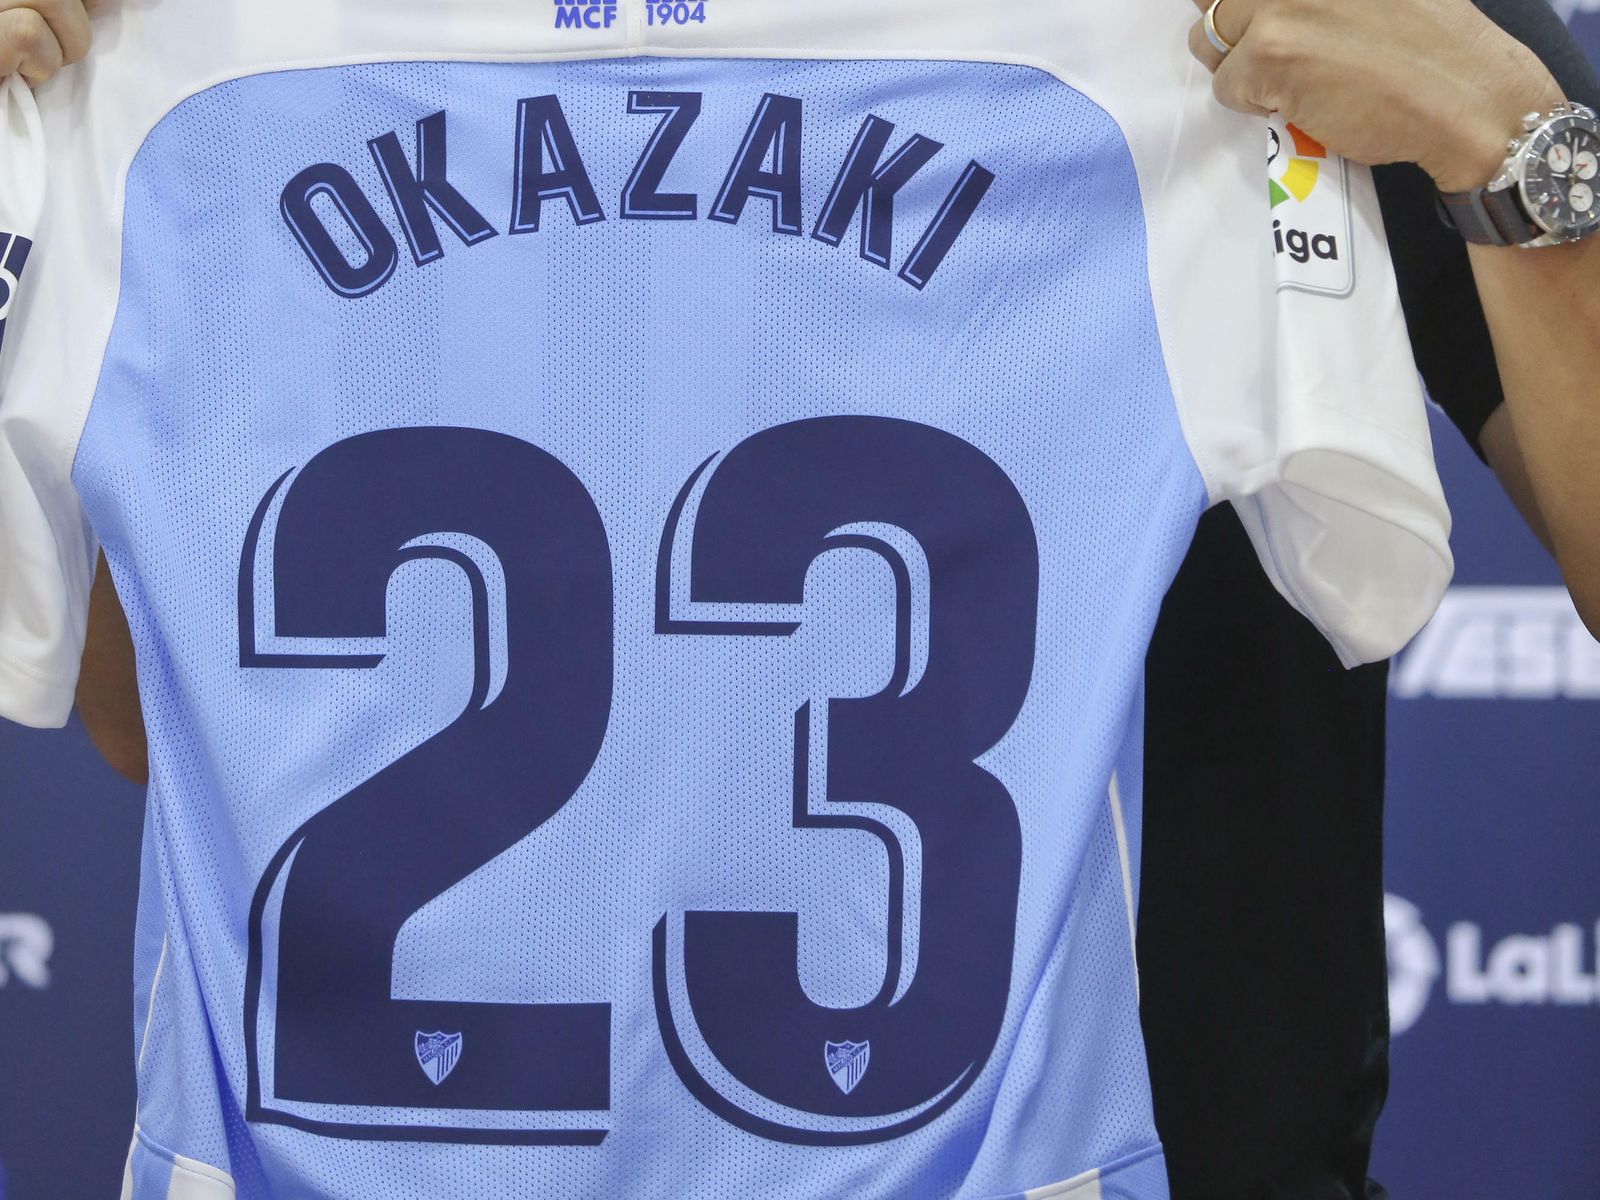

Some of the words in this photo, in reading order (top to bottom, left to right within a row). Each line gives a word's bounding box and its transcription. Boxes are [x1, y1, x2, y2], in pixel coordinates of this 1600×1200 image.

[554, 6, 617, 29] MCF
[645, 2, 706, 26] 1904
[279, 90, 997, 300] OKAZAKI
[237, 414, 1040, 1147] 23
[1447, 920, 1600, 1005] LaL
